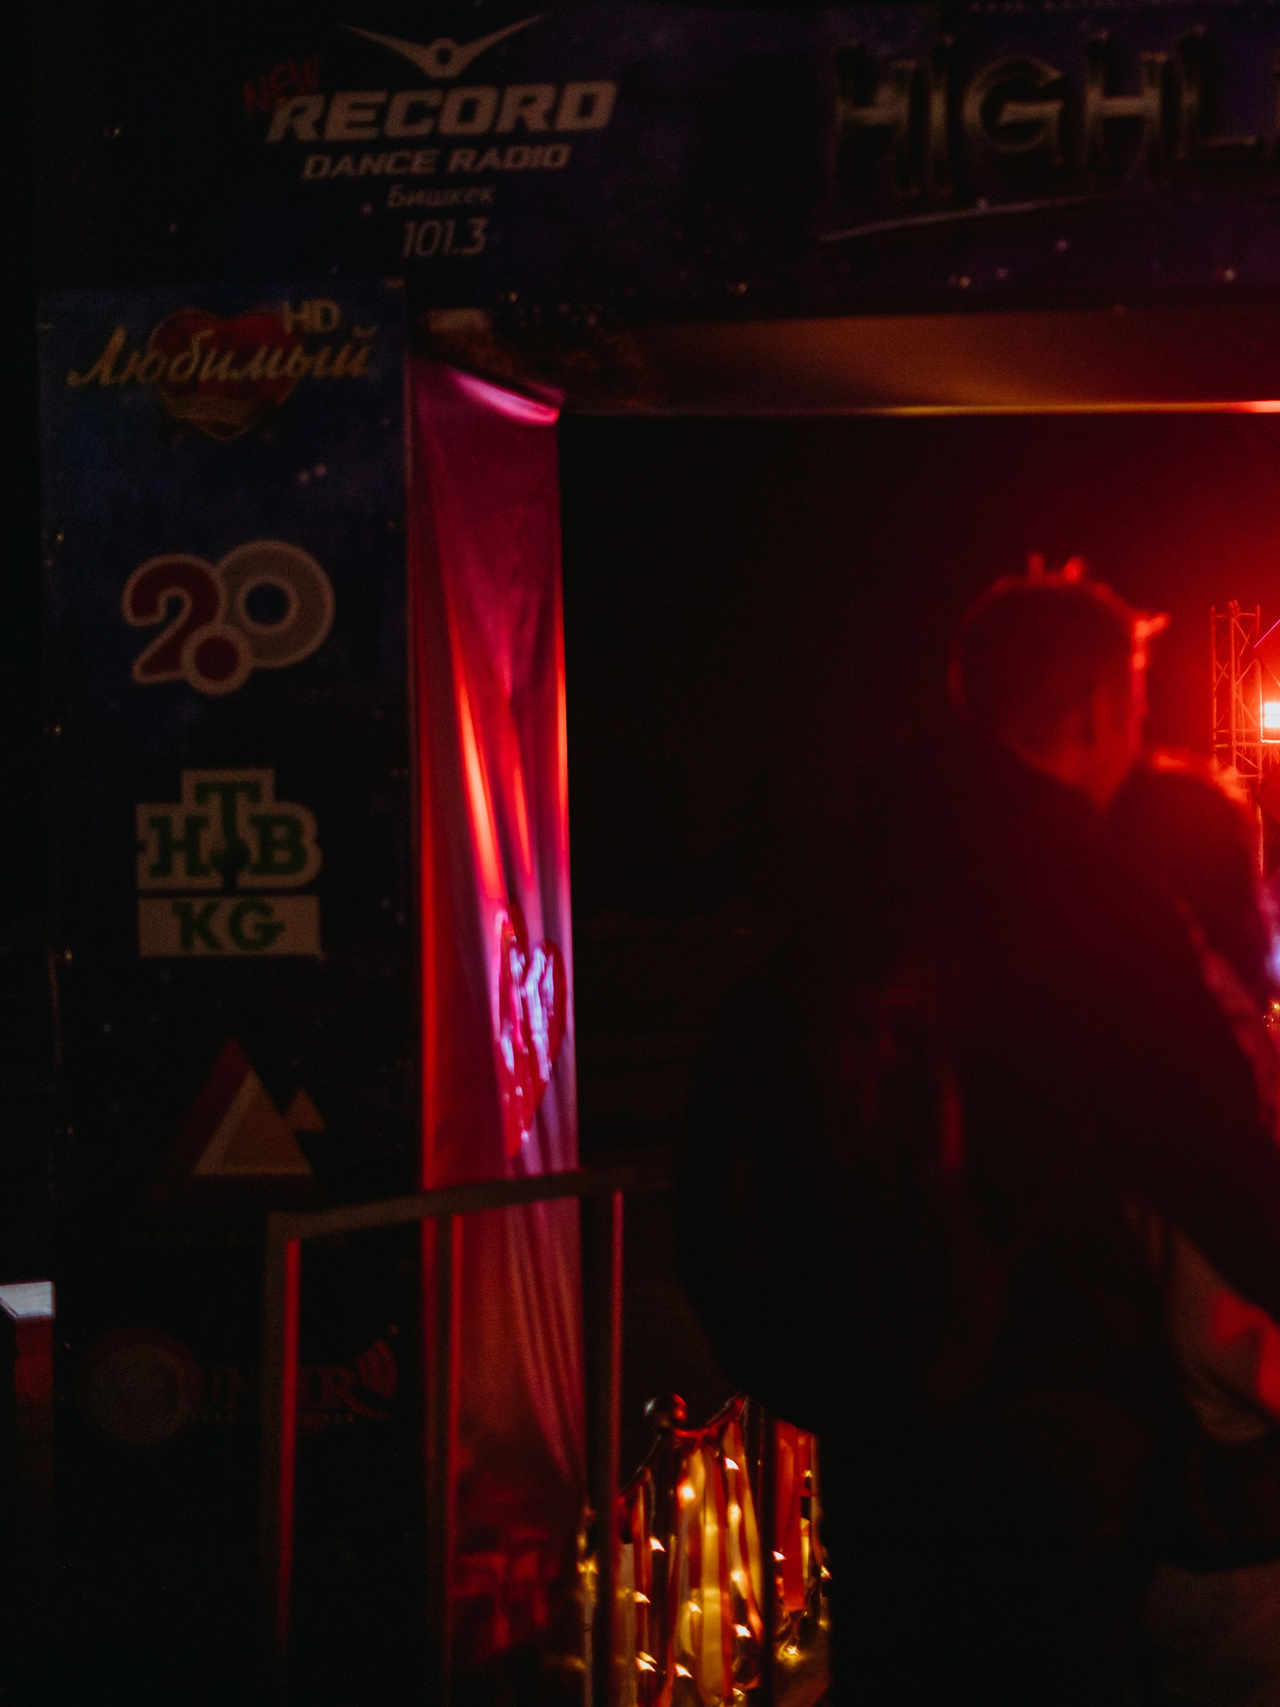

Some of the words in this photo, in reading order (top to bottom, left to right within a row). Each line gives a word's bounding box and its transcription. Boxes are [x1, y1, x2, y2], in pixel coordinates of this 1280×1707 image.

[265, 80, 618, 143] RECORD
[302, 147, 440, 180] DANCE
[448, 142, 572, 175] RADIO
[386, 181, 496, 210] Бишкек
[401, 216, 489, 259] 101.3
[282, 300, 343, 335] HD
[65, 325, 378, 389] Любимый
[171, 900, 285, 952] KG
